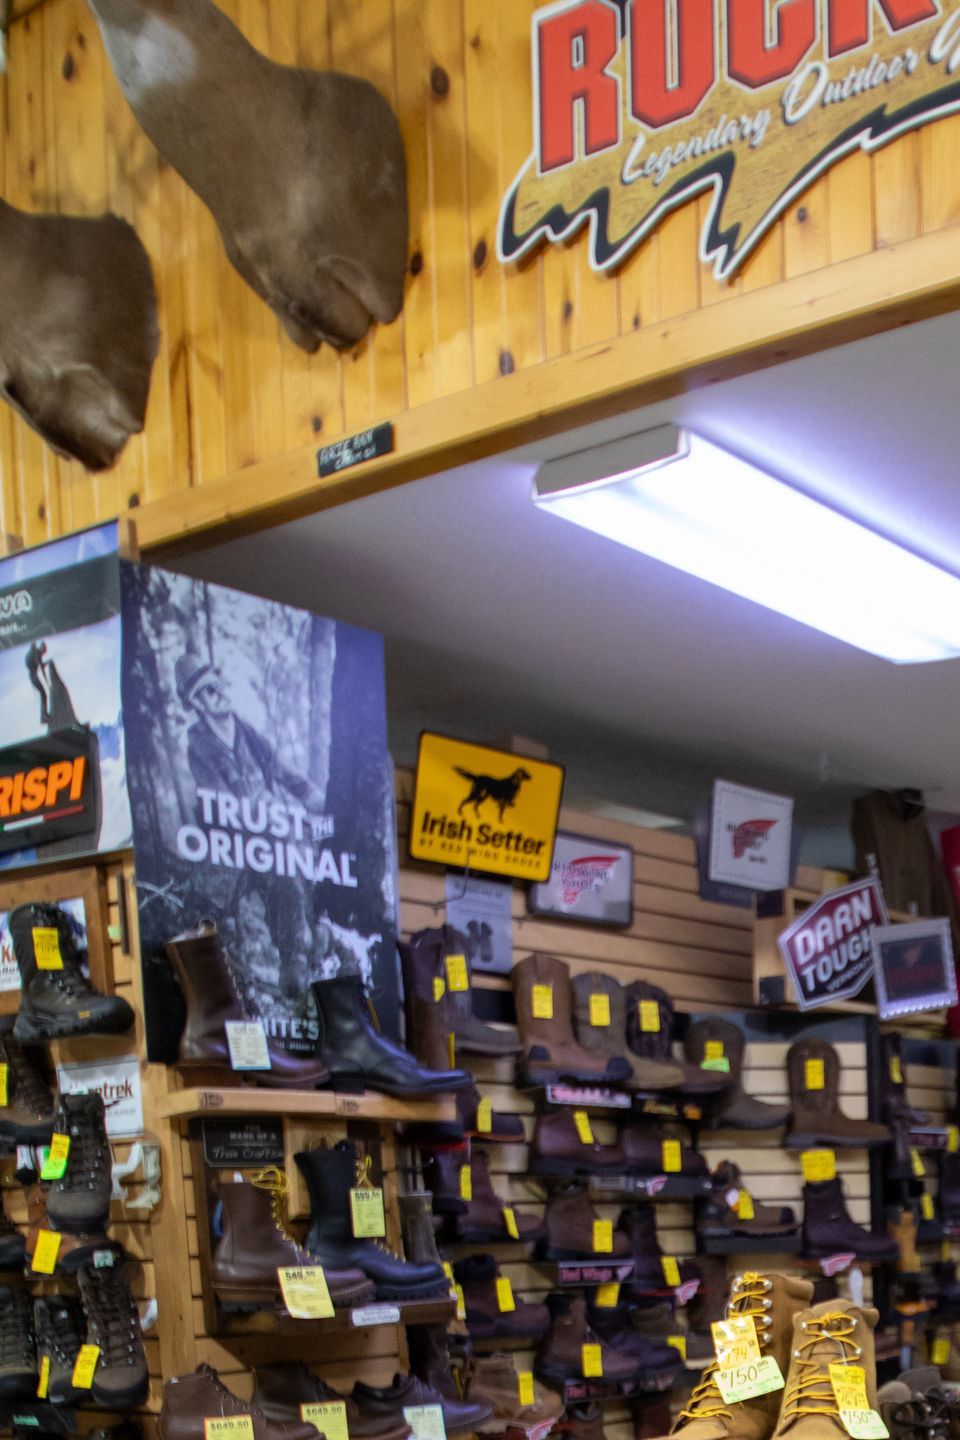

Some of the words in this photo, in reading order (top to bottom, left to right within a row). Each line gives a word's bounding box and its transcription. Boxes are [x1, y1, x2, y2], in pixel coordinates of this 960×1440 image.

[622, 108, 770, 185] Legendary
[782, 49, 918, 124] Outdoor
[197, 786, 307, 841] TRUST
[311, 814, 335, 841] THE
[421, 811, 473, 842] Irish
[476, 823, 546, 855] Setter
[177, 824, 358, 889] ORIGINAL
[795, 888, 872, 965] DARN
